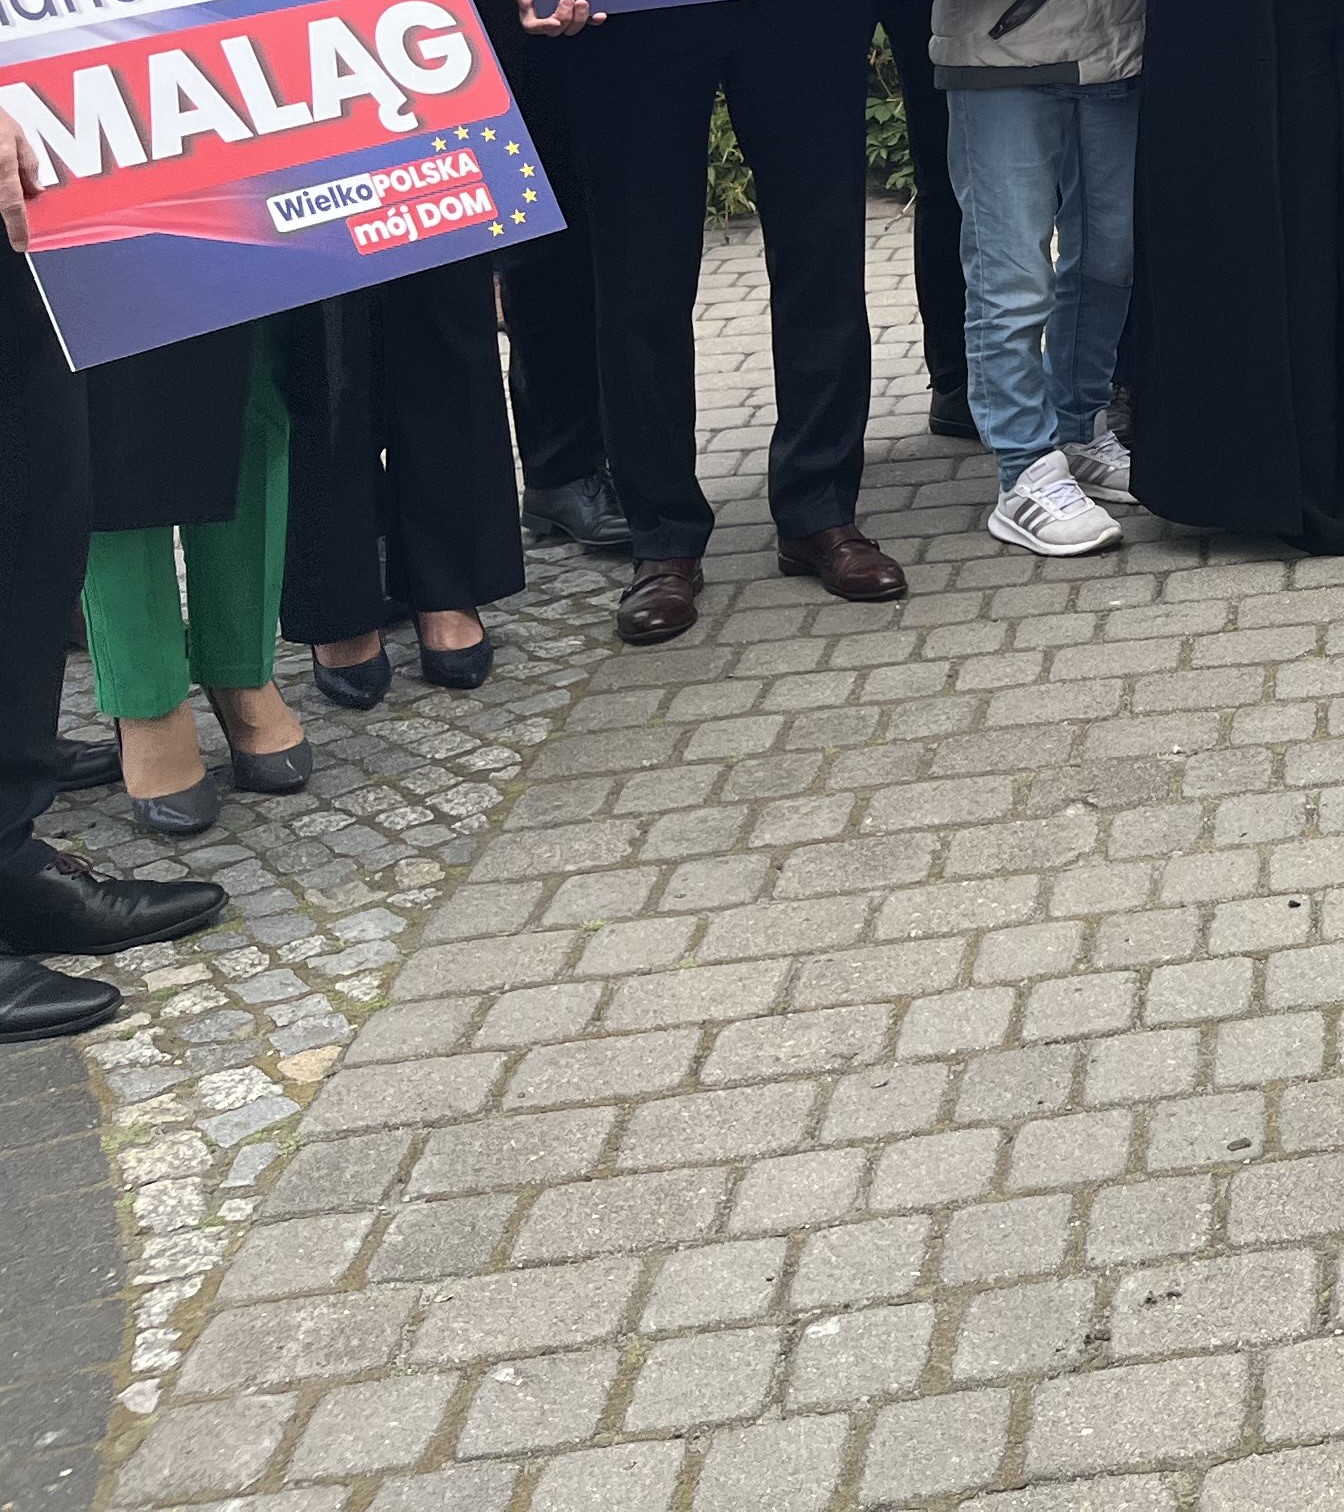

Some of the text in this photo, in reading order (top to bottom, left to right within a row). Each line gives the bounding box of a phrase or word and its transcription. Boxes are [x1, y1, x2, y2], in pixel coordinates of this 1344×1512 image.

[0, 0, 472, 187] MALĄG
[274, 153, 479, 223] WielkoPOLSKA
[355, 189, 492, 245] mój DOM
